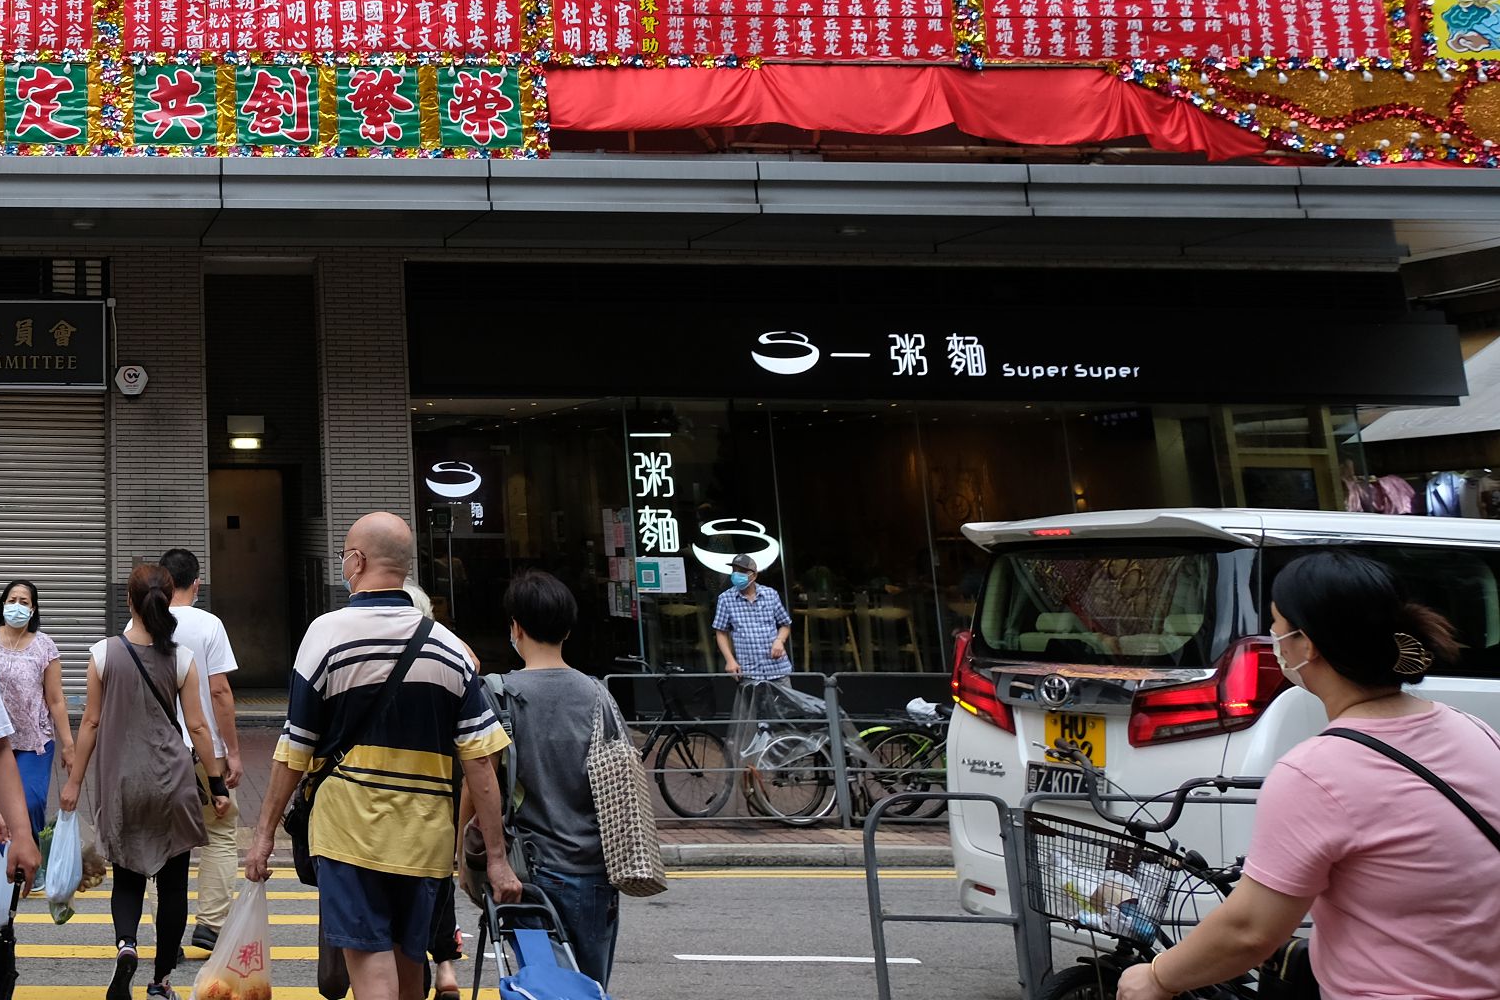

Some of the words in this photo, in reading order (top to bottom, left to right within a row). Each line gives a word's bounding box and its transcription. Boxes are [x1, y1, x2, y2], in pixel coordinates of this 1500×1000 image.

[151, 66, 515, 145] 共創繁榮
[1002, 363, 1067, 380] Super
[1075, 363, 1140, 380] Super
[1061, 715, 1086, 739] HU
